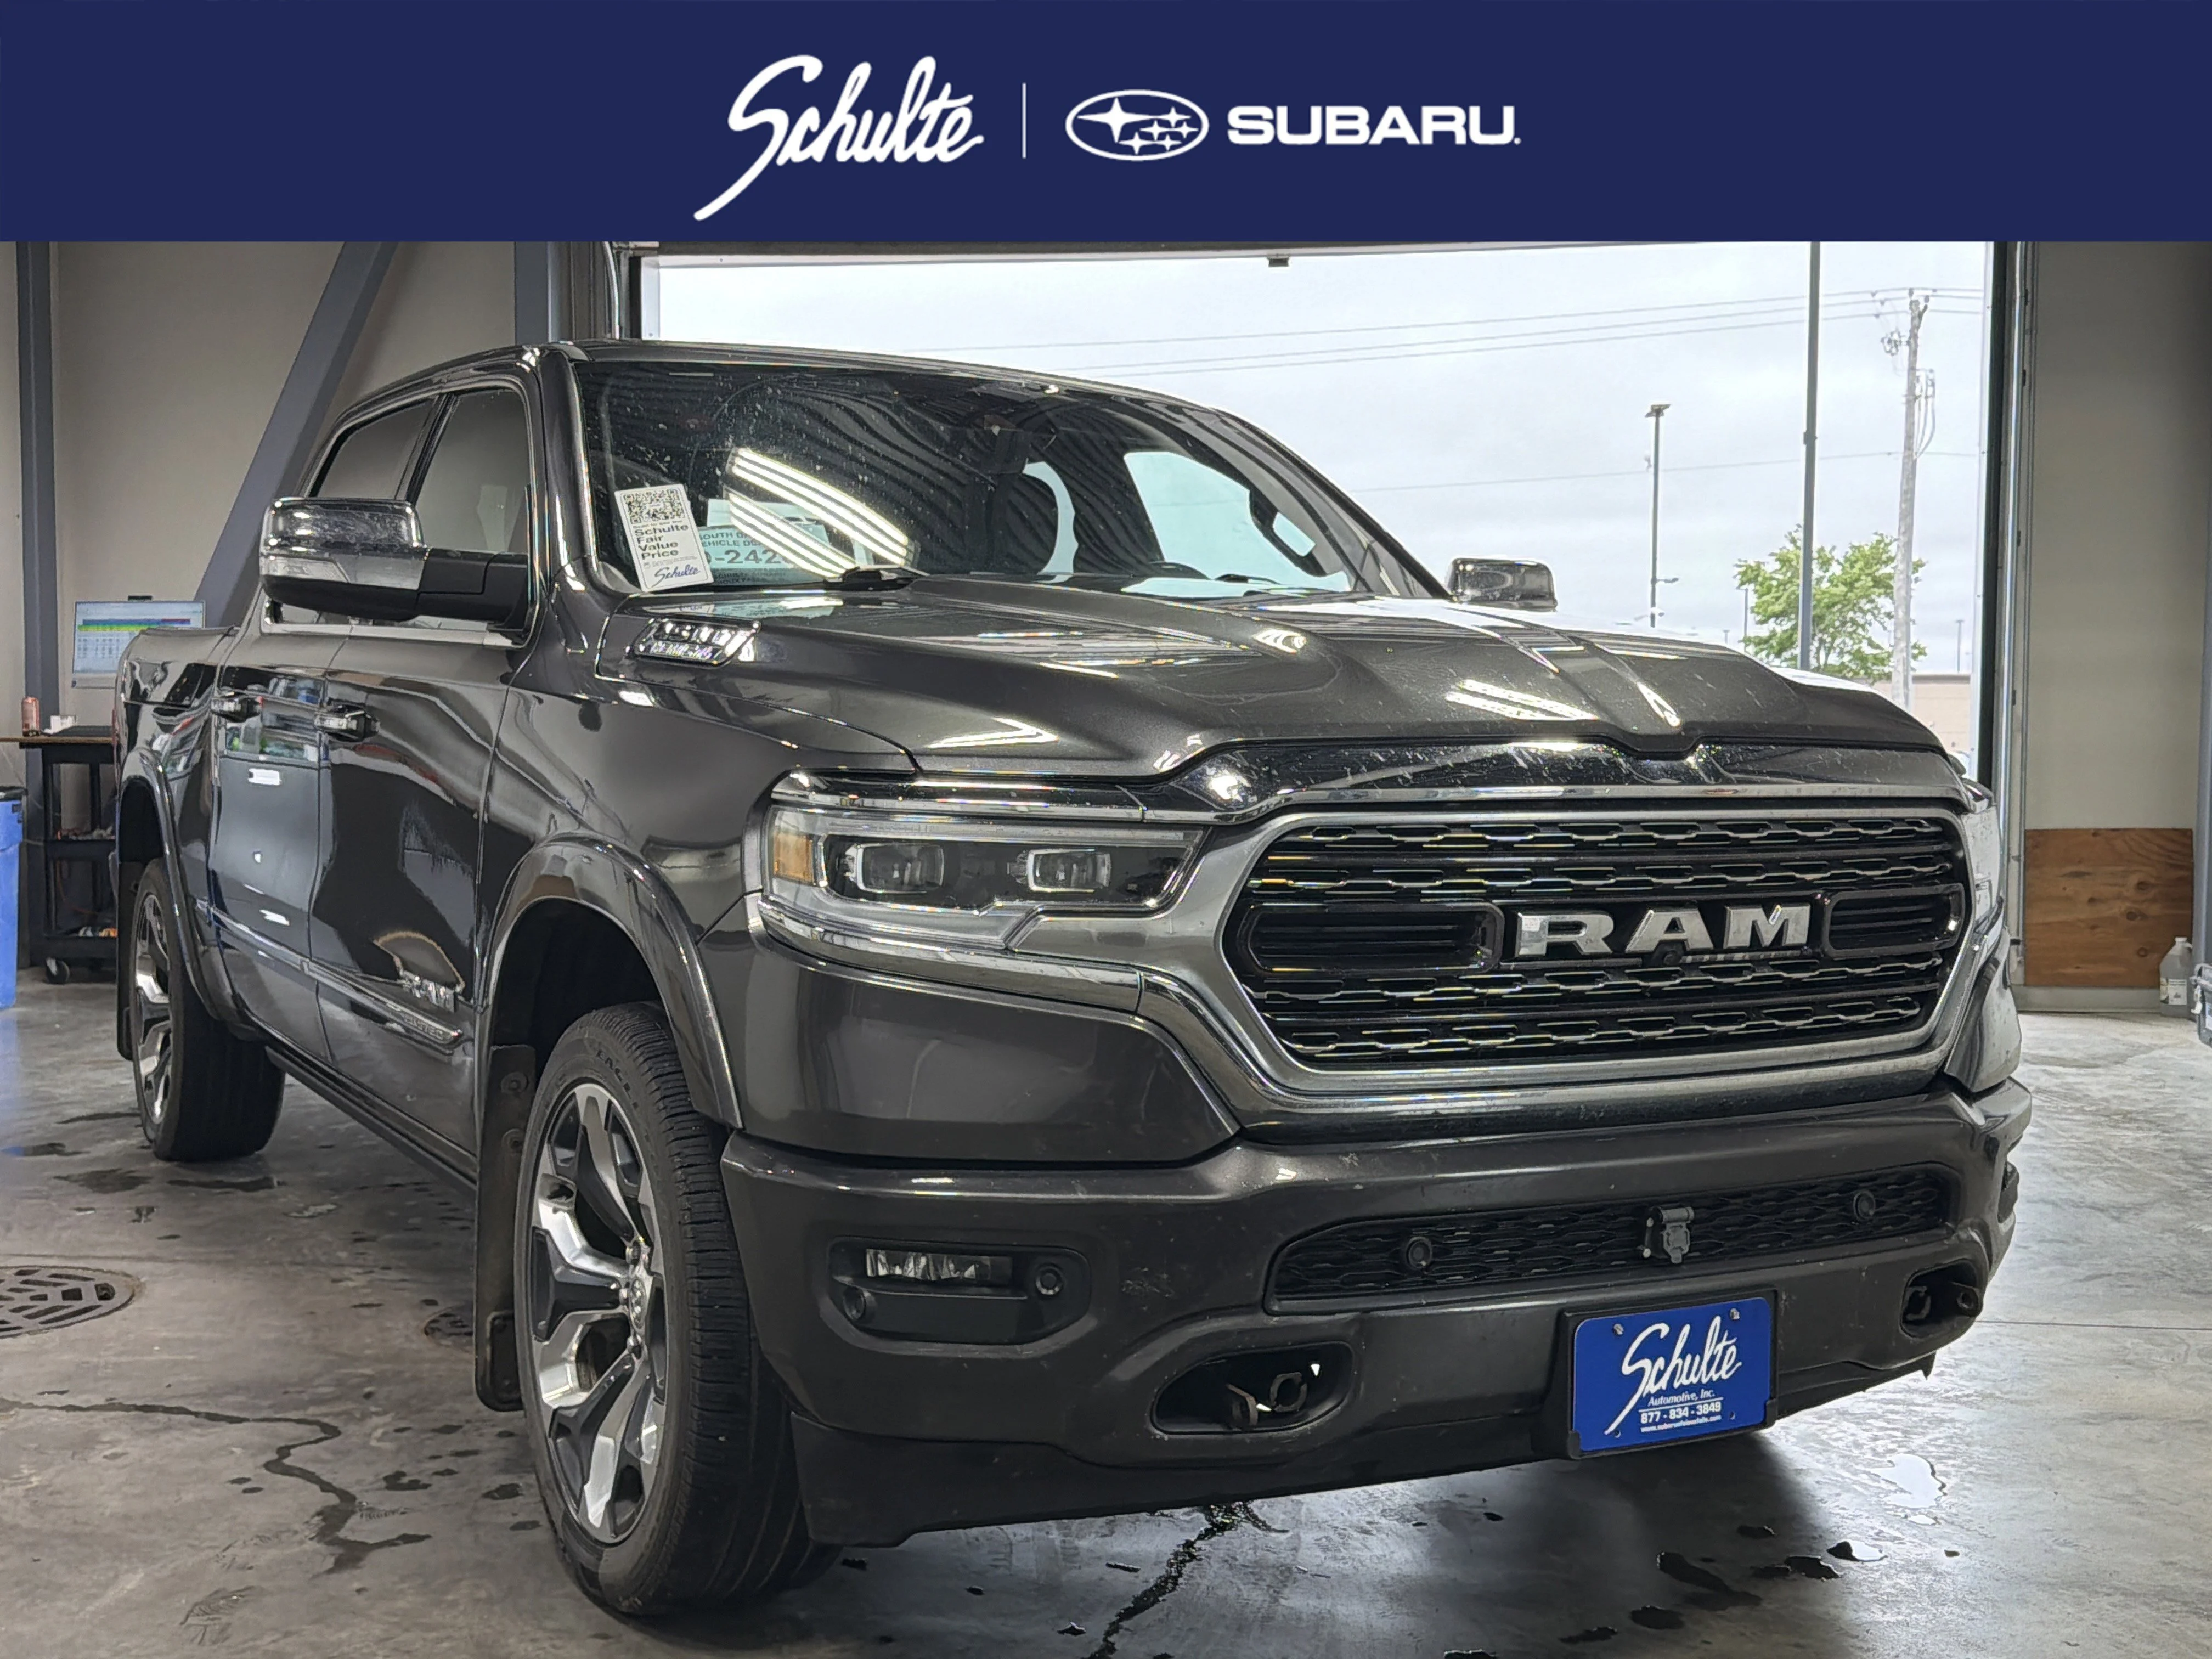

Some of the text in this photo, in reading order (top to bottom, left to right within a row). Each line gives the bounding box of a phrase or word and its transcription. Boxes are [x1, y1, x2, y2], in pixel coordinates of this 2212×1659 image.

[634, 524, 689, 536] Schulte
[637, 534, 664, 545] Fair
[638, 541, 679, 552] Value
[641, 550, 679, 560] Price
[651, 564, 701, 588] Schulte
[1515, 904, 1811, 957] RAM
[1604, 1316, 1742, 1435] Schulte
[1700, 1388, 1716, 1399] Inc.
